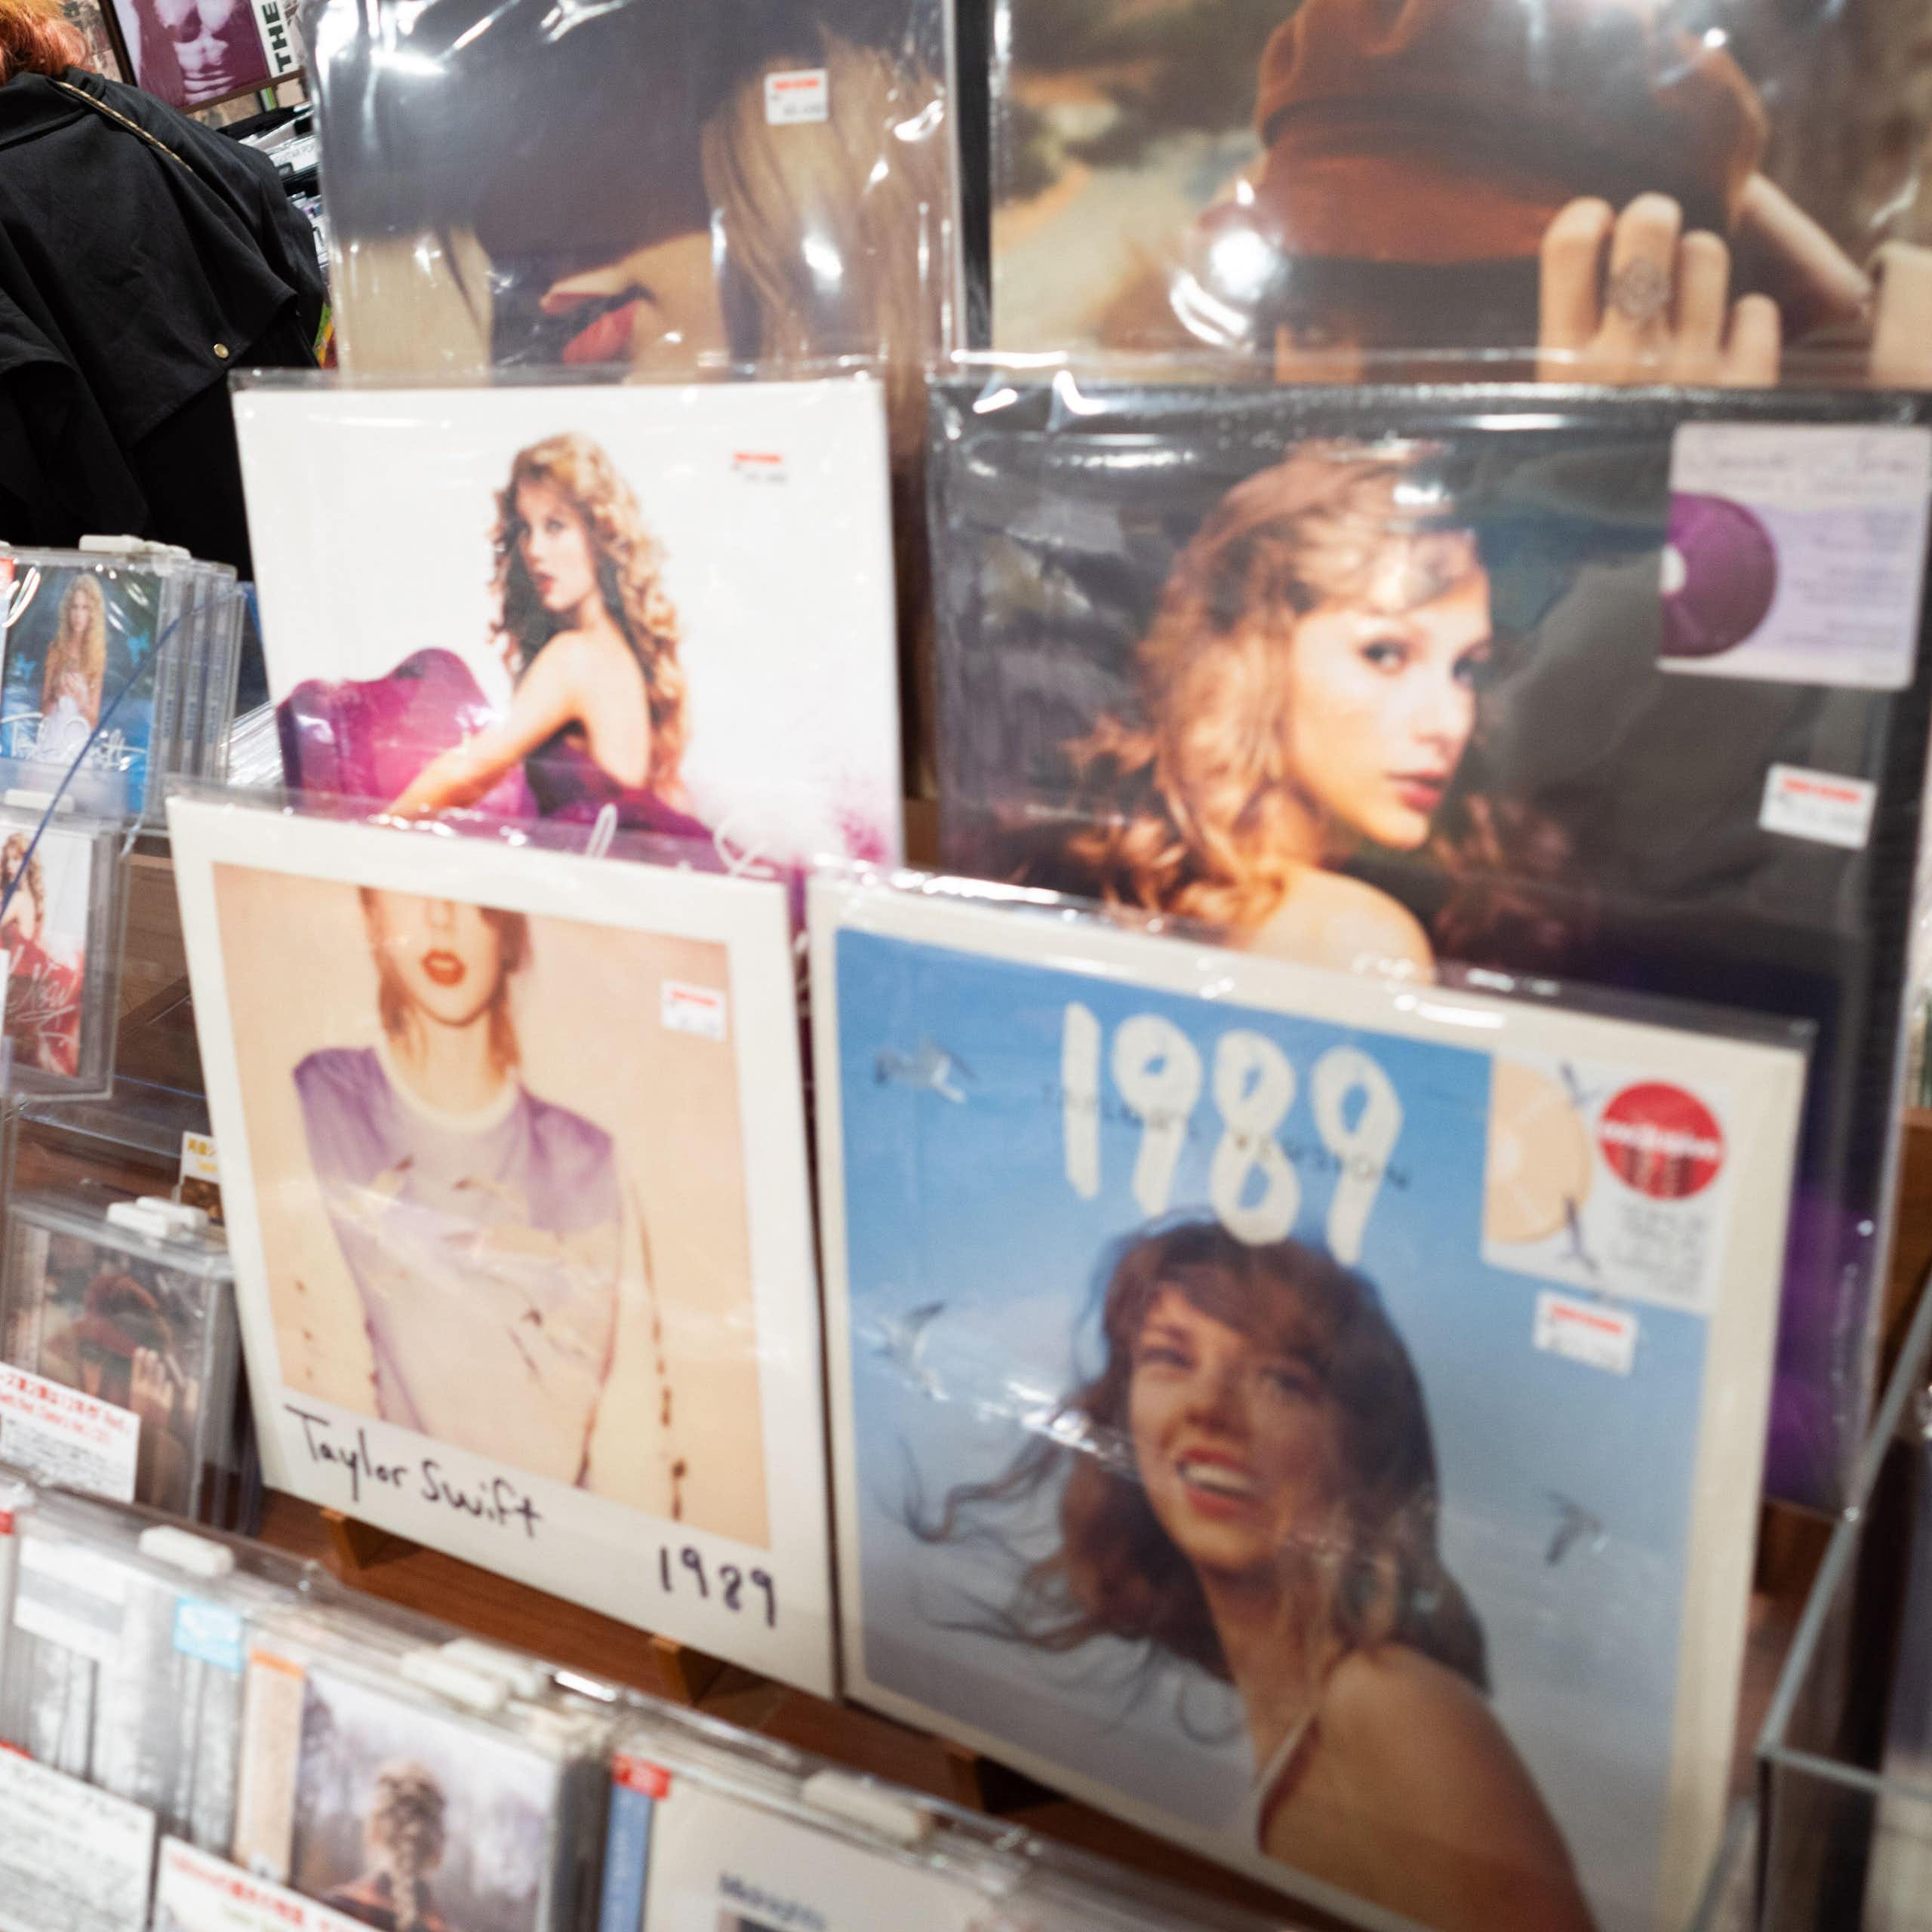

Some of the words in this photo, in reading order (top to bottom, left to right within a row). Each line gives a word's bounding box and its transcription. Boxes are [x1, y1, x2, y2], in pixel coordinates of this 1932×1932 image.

[261, 1, 292, 73] THE
[1060, 1000, 1404, 1268] 1989
[284, 1402, 408, 1504] Taylor
[421, 1457, 543, 1540] Swift
[658, 1544, 777, 1629] 1989
